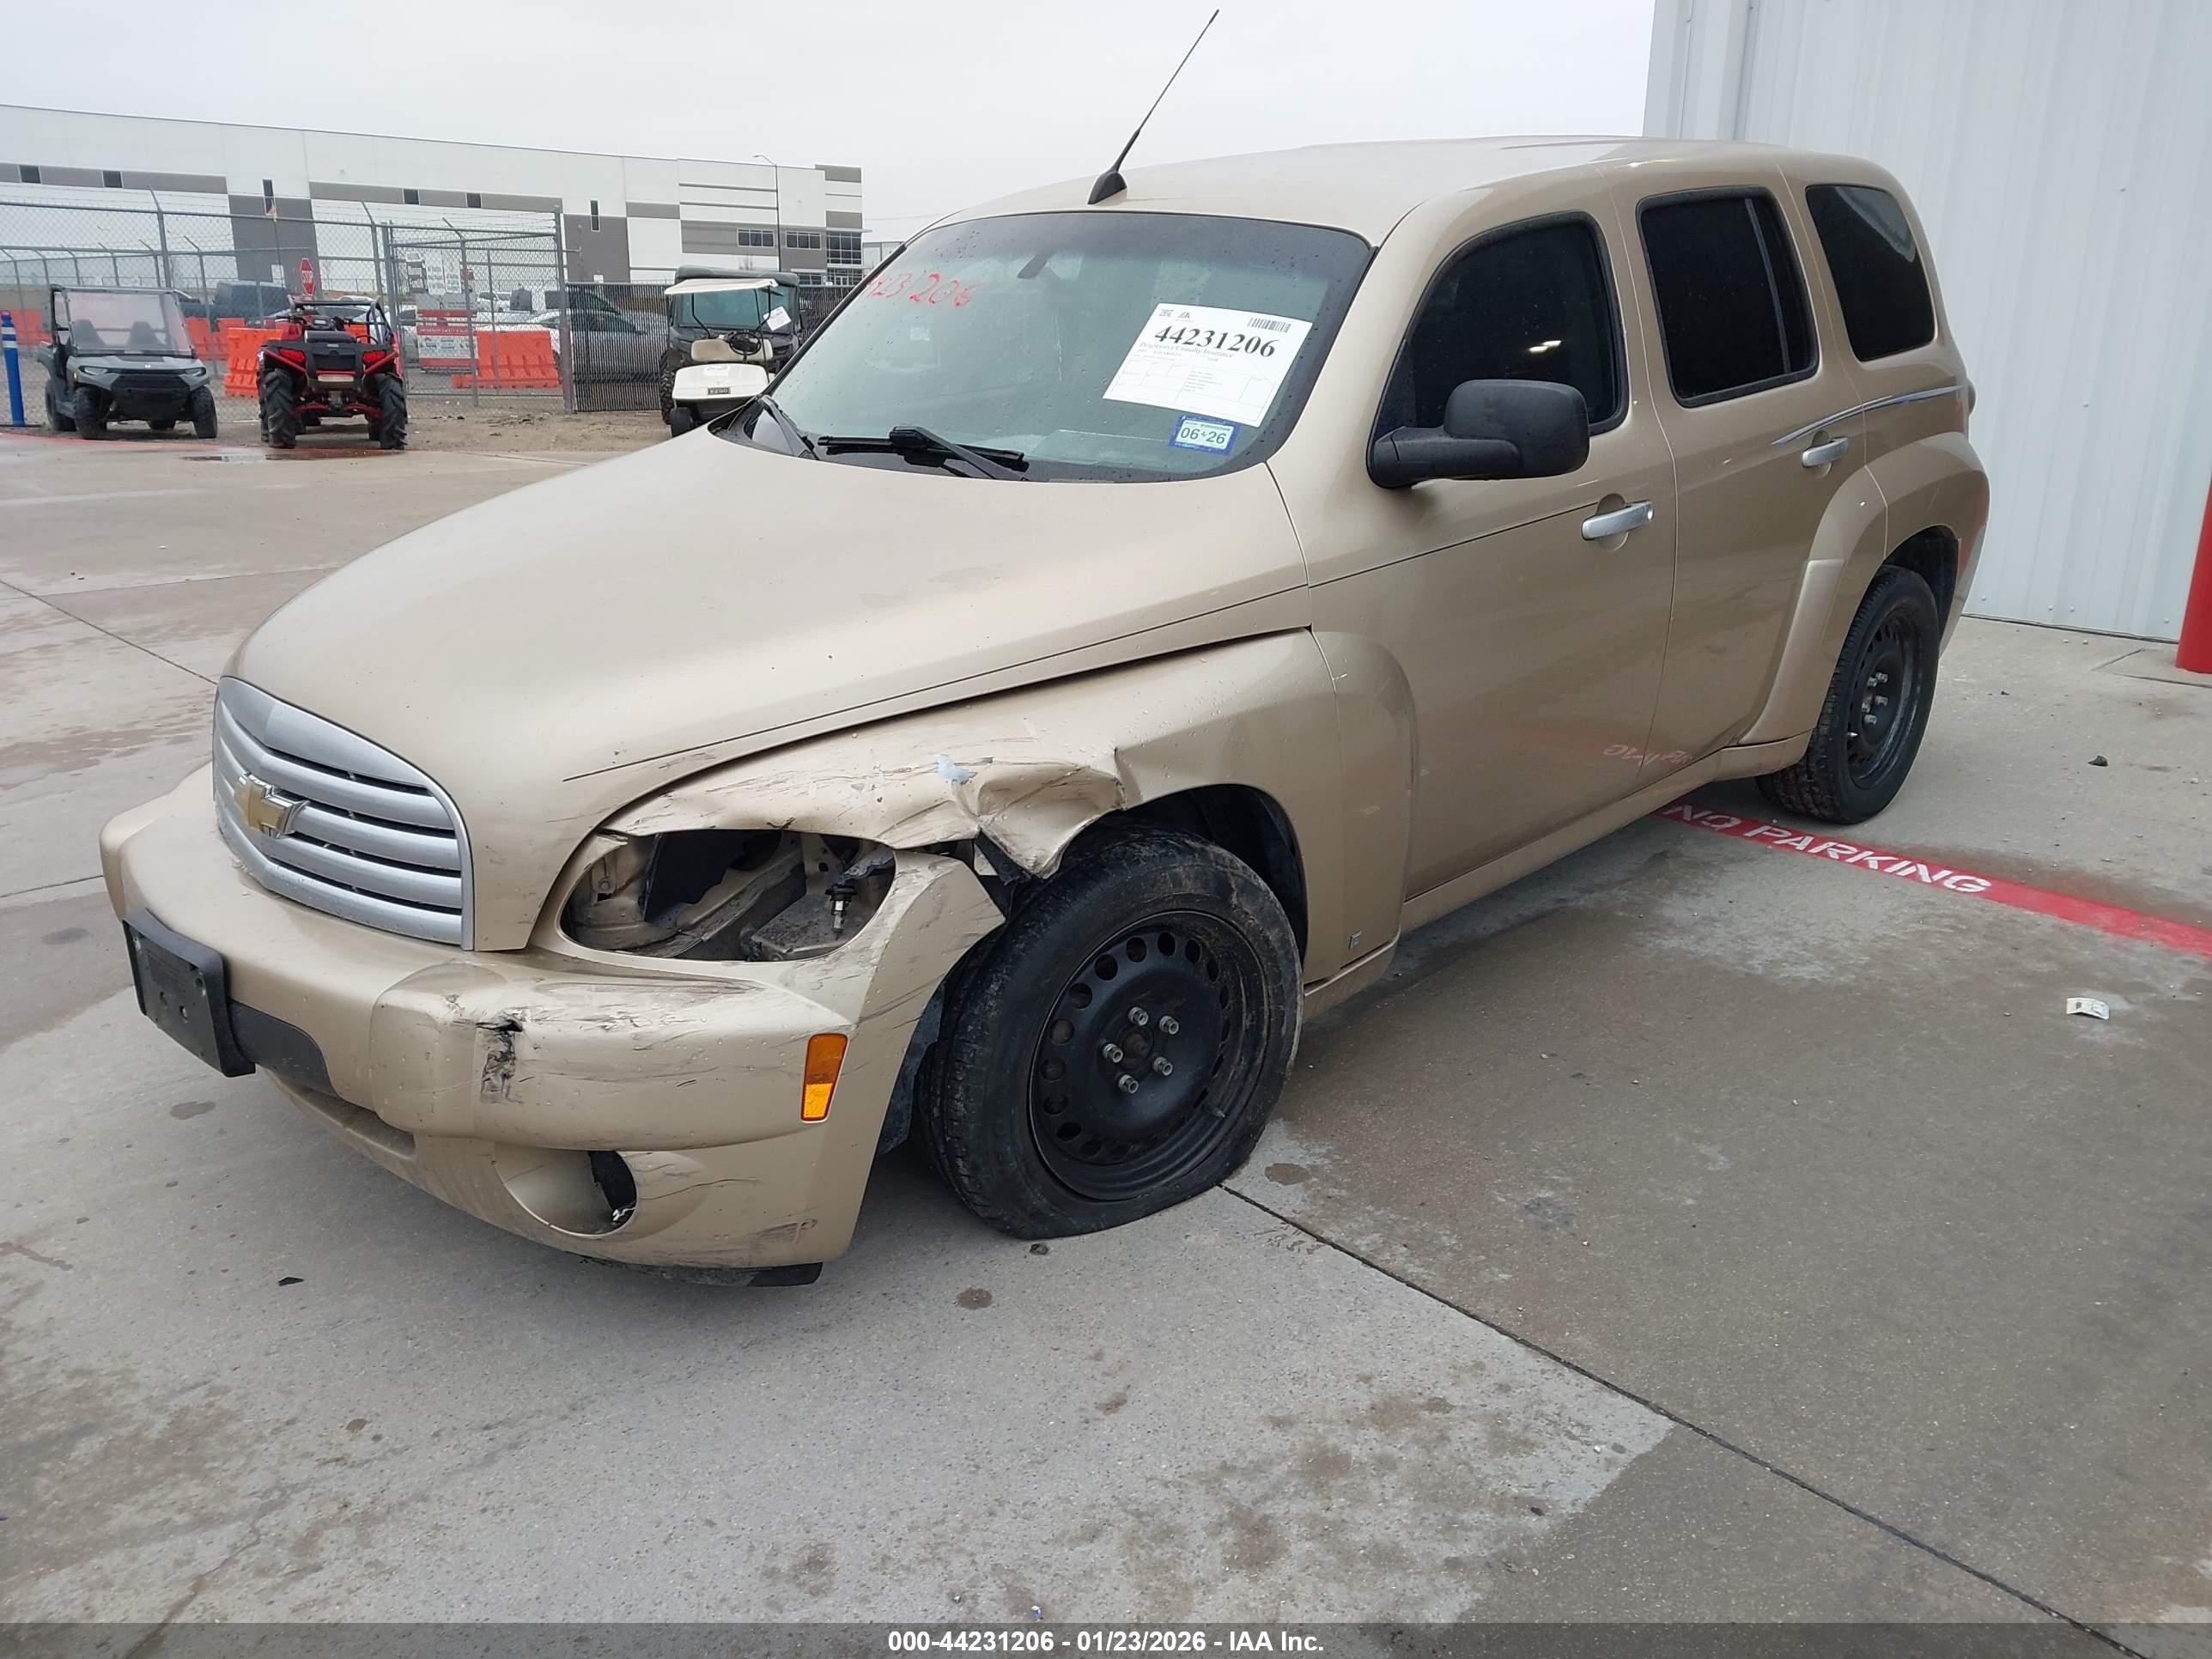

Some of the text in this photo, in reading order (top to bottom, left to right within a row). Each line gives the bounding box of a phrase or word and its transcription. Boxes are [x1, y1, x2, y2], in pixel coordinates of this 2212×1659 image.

[301, 270, 314, 283] STOP
[1155, 325, 1280, 357] 44231206
[1181, 428, 1227, 444] 06 26
[1662, 804, 1993, 893] NO PARKING
